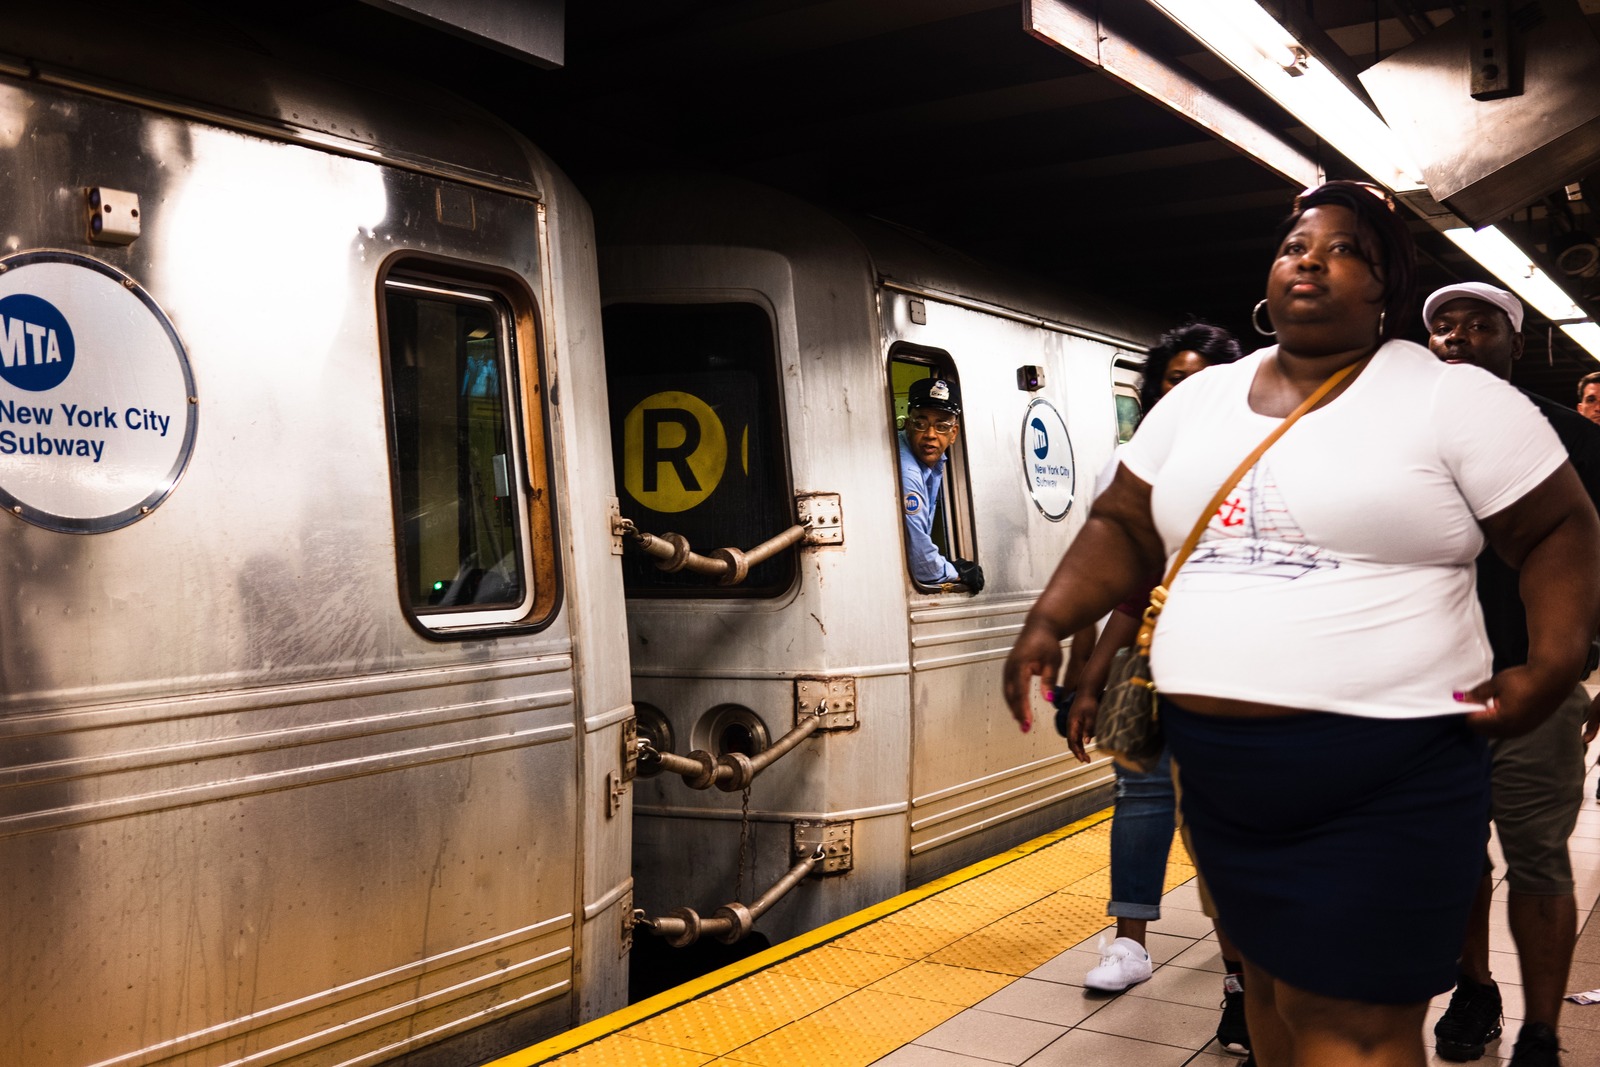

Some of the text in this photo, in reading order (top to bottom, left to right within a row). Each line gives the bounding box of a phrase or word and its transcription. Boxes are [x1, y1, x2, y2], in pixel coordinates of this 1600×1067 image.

[0, 400, 171, 437] New York City
[0, 430, 105, 463] Subway
[643, 408, 703, 491] R
[1035, 463, 1070, 478] New York City
